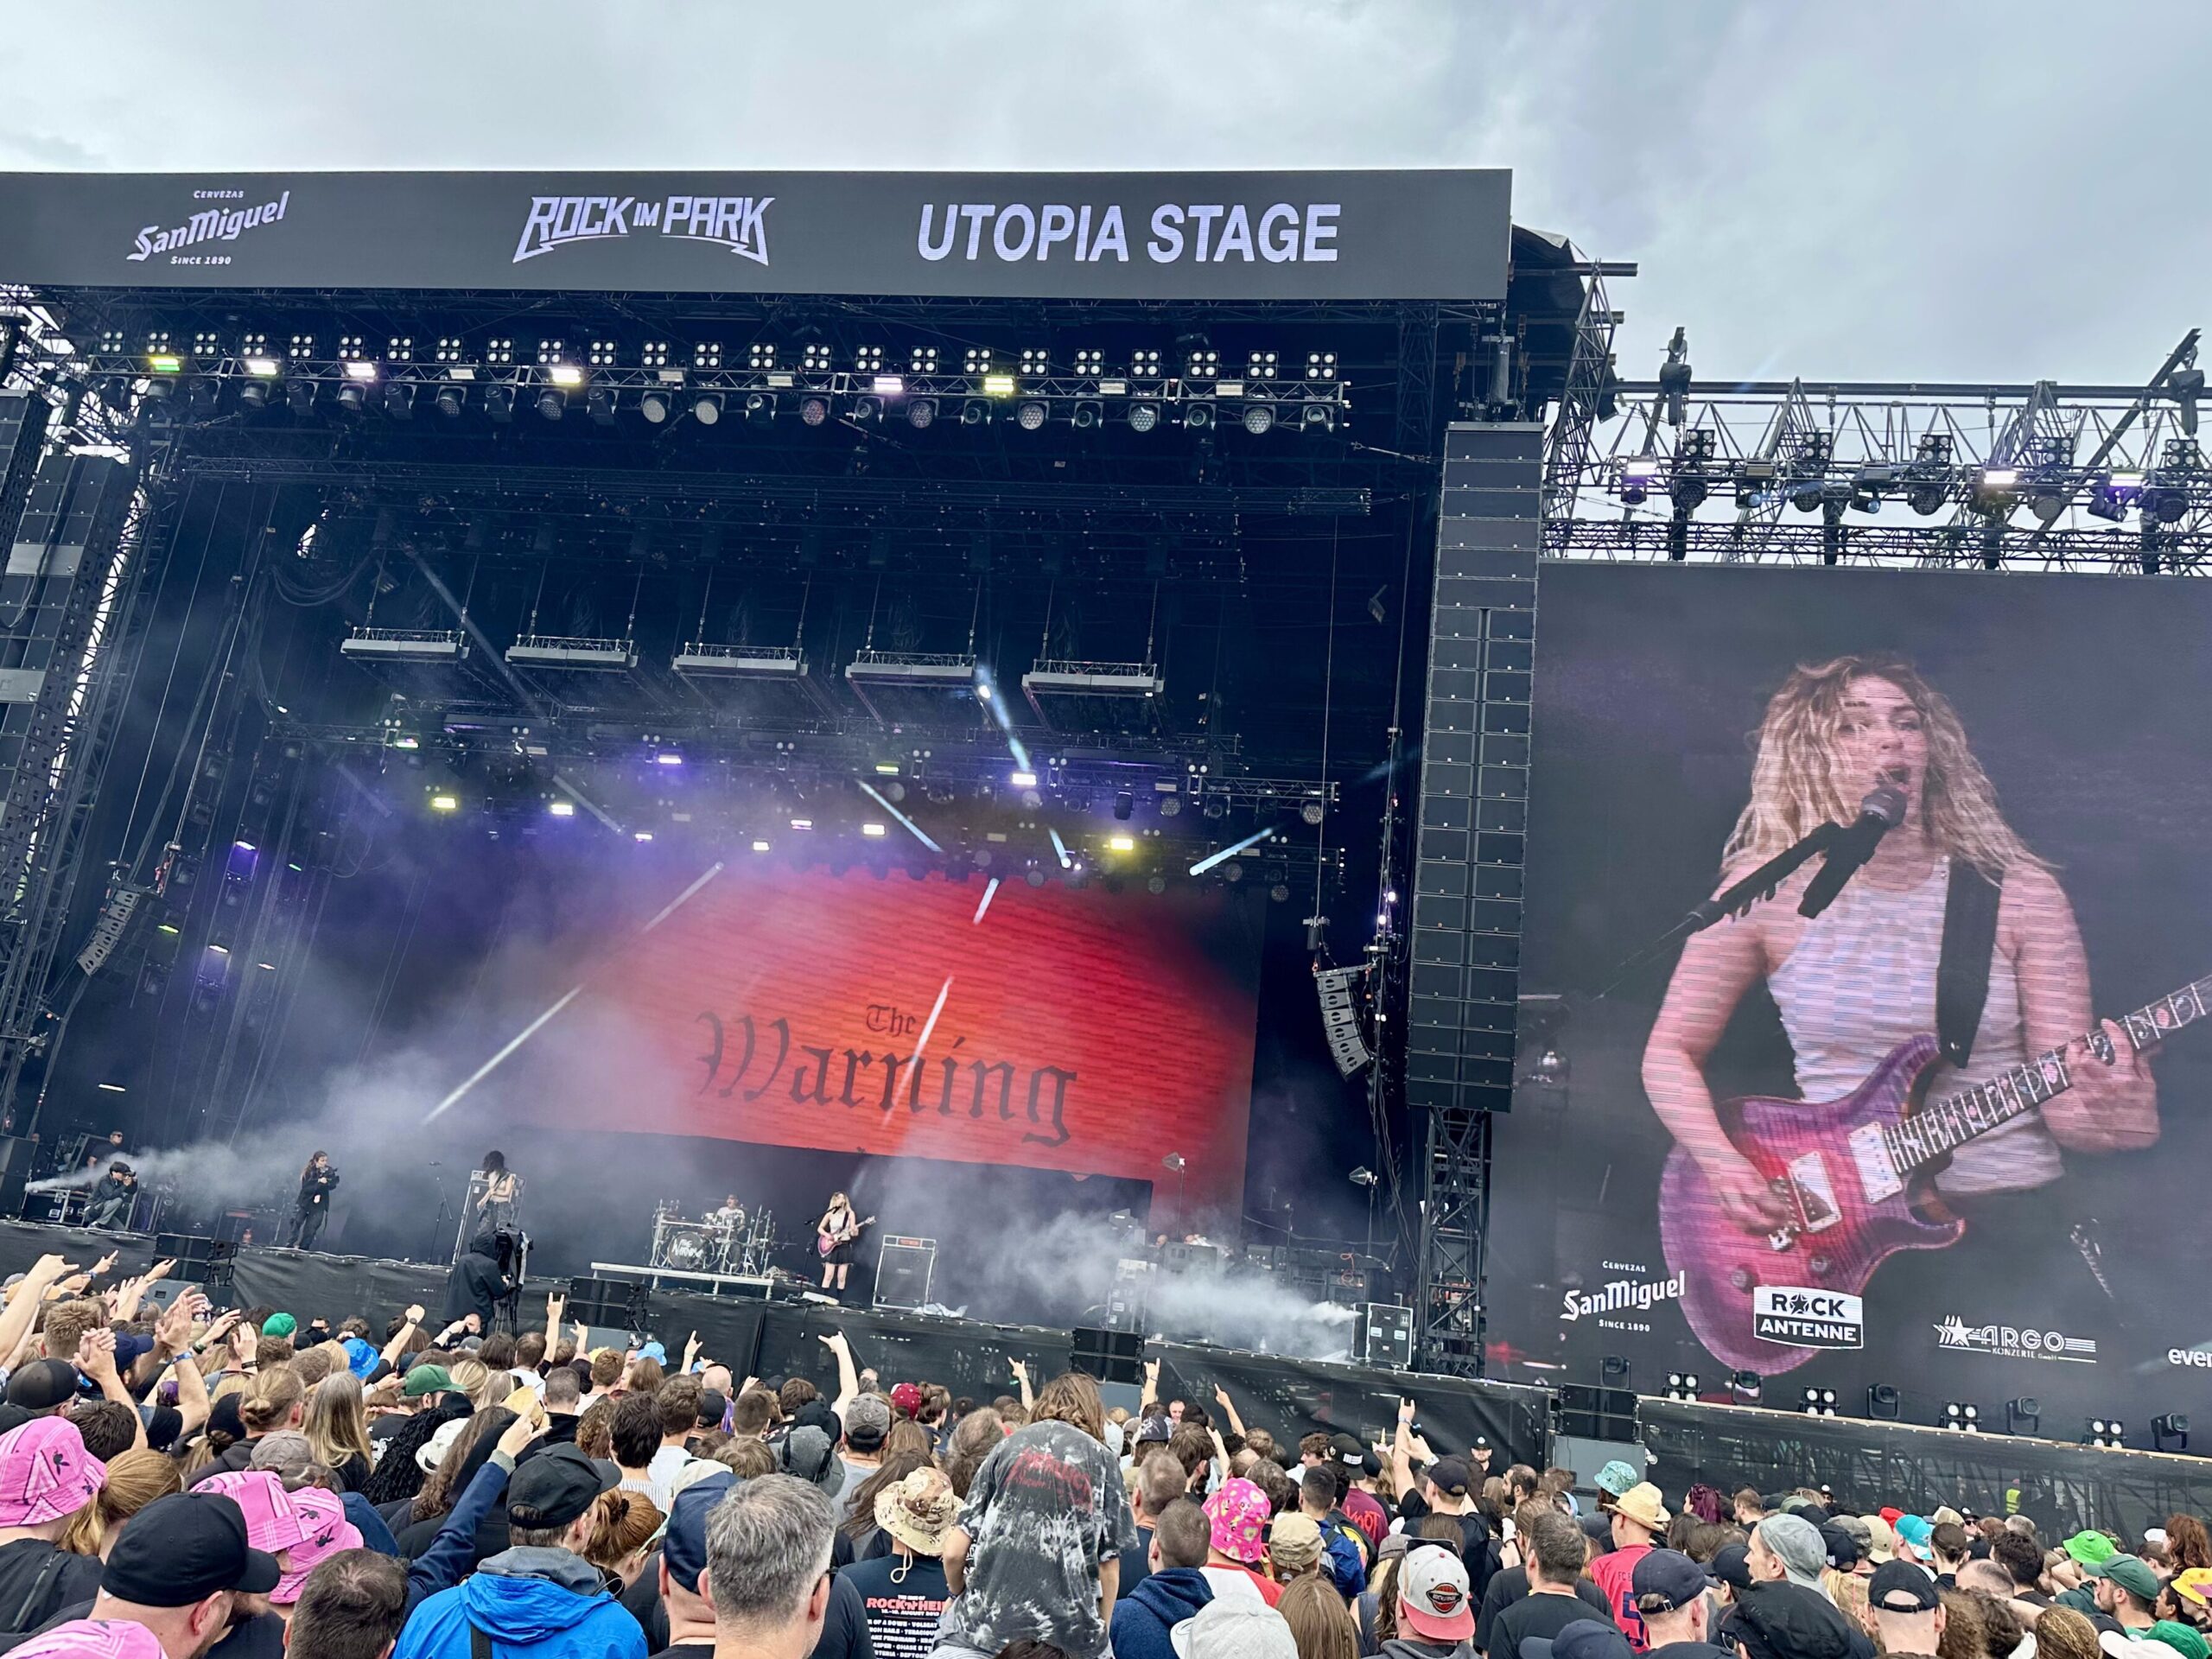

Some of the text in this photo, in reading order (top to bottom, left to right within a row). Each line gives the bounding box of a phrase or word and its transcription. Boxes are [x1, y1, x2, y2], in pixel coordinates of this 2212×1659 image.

[194, 190, 245, 199] CERVEZAS
[512, 196, 775, 266] ROCK IM PARK
[918, 203, 1341, 263] UTOPIA STAGE
[170, 256, 232, 265] SINCE 1890
[866, 1004, 917, 1037] The
[695, 1011, 1077, 1147] Warning
[1602, 1261, 1646, 1273] CERVEZAS
[1599, 1319, 1650, 1332] SINCE 1890
[1760, 1319, 1857, 1342] ANTENNE
[1980, 1325, 2066, 1352] ARGO
[1992, 1347, 2035, 1358] KONZERTE
